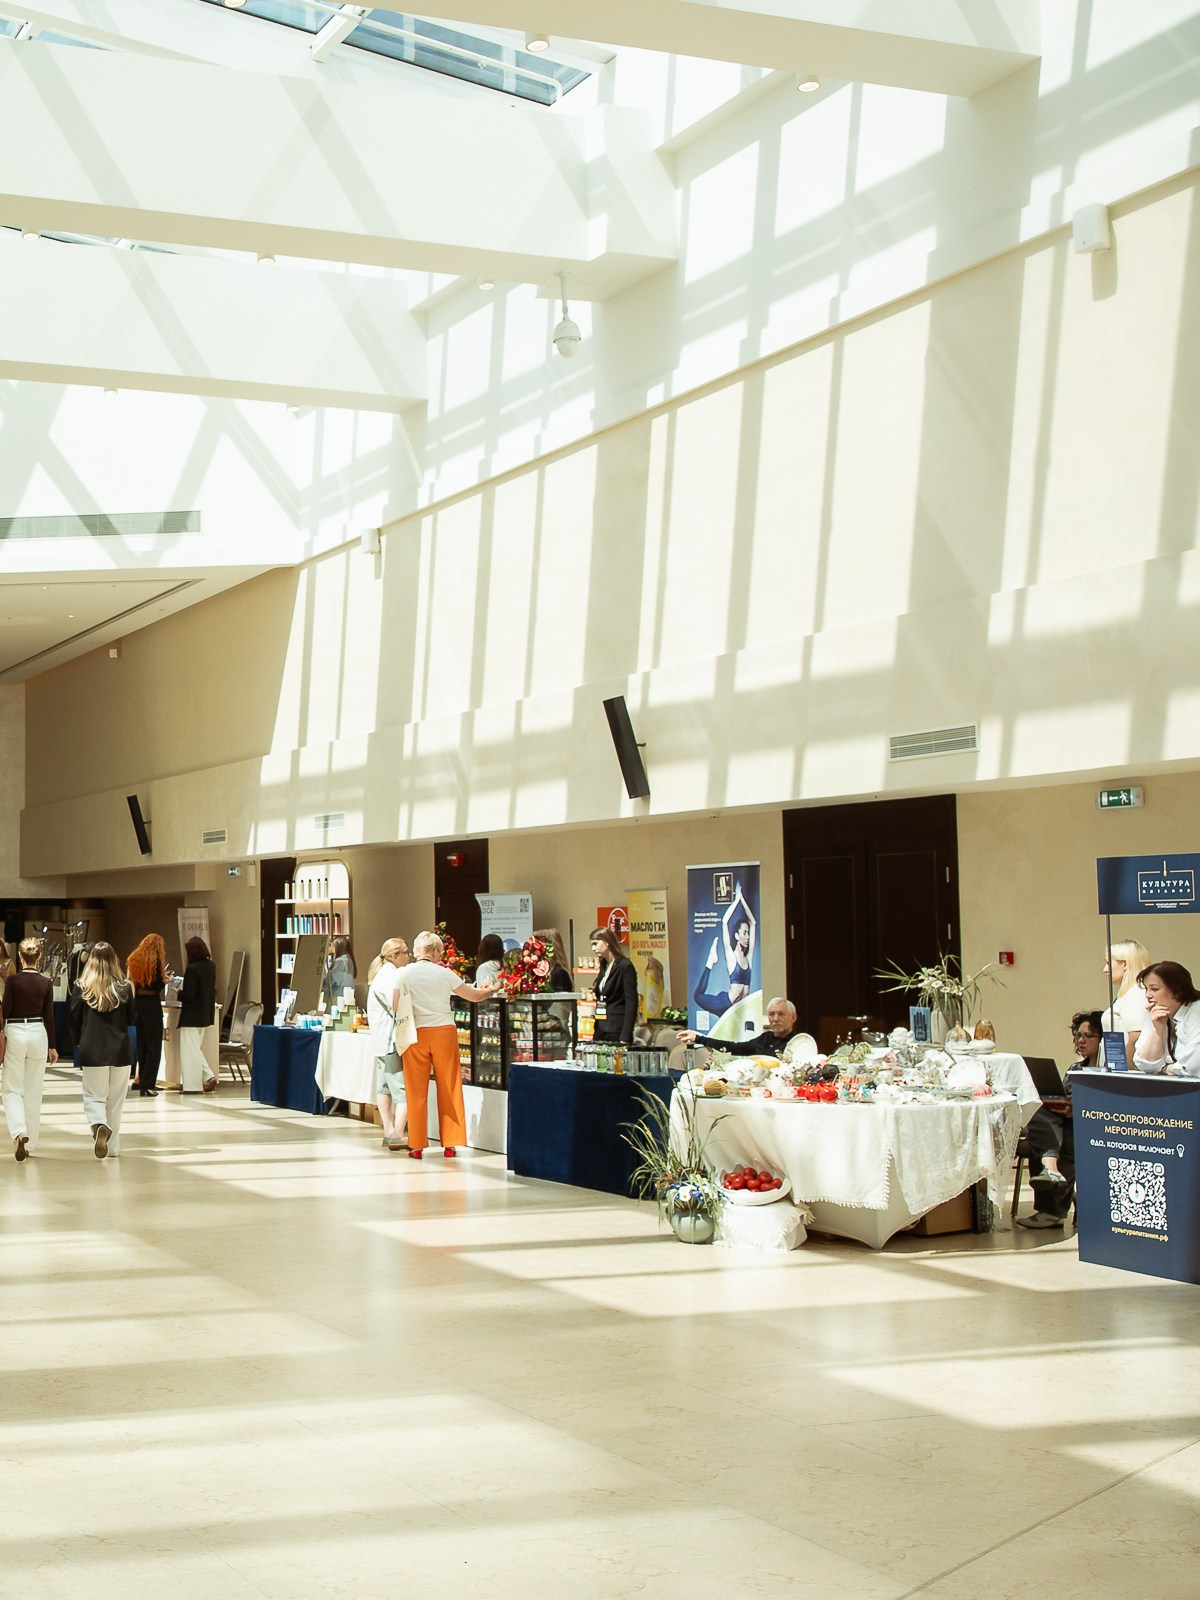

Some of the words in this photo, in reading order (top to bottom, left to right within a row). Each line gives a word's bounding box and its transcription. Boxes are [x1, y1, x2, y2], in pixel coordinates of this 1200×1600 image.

[1142, 880, 1190, 888] КУЛЬТУРА
[630, 921, 653, 932] МАСЛО
[653, 921, 666, 932] ГХИ
[631, 941, 640, 950] ДО
[1081, 1109, 1193, 1130] ГАСТРО-СОПРОВОЖДЕНИЕ
[1104, 1125, 1166, 1139] МЕРОПРИЯТИЙ
[1090, 1139, 1106, 1148] еда,
[1106, 1141, 1137, 1151] которая
[1138, 1144, 1175, 1155] включает
